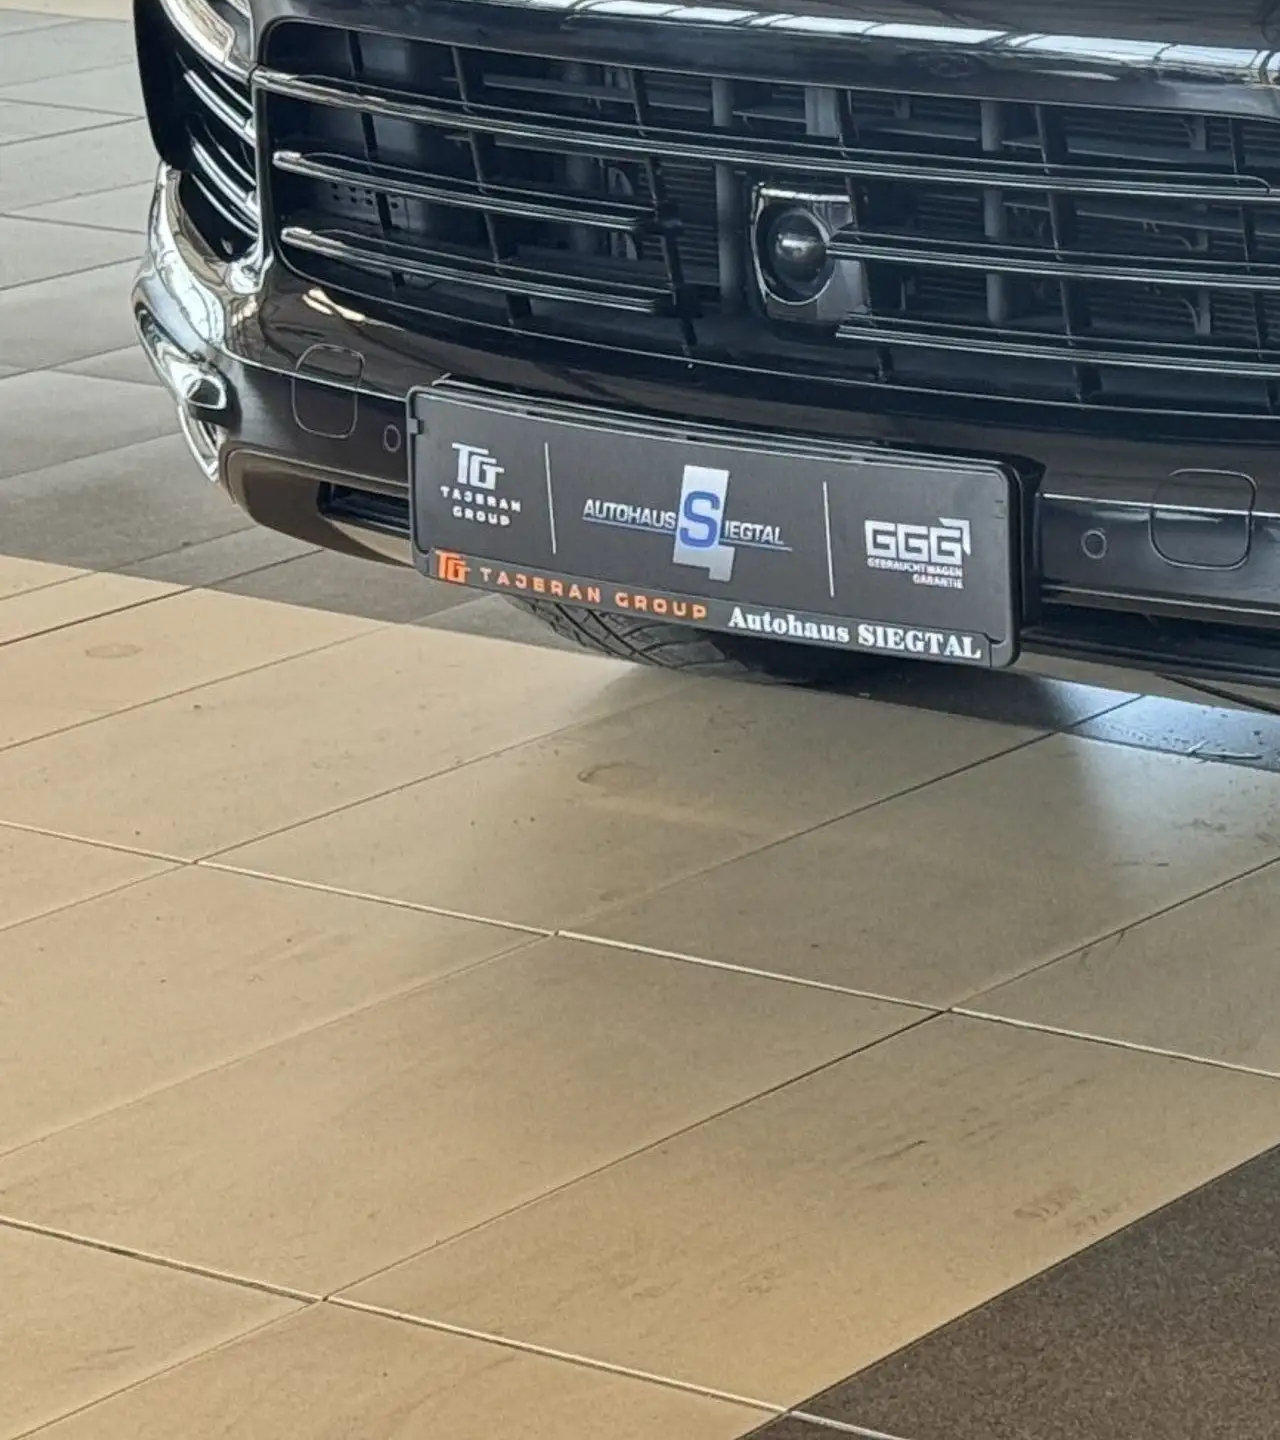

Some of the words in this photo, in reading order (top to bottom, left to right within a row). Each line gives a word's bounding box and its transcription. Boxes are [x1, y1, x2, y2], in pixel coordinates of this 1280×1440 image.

[440, 485, 521, 513] TAJERAN
[452, 505, 510, 526] GROUP
[583, 498, 677, 530] AUTOHAUS
[864, 519, 963, 565] GGG
[479, 566, 601, 603] TAJERAN
[614, 591, 708, 620] GROUP
[728, 606, 850, 643] Autohaus
[857, 623, 982, 659] SIEGTAL
